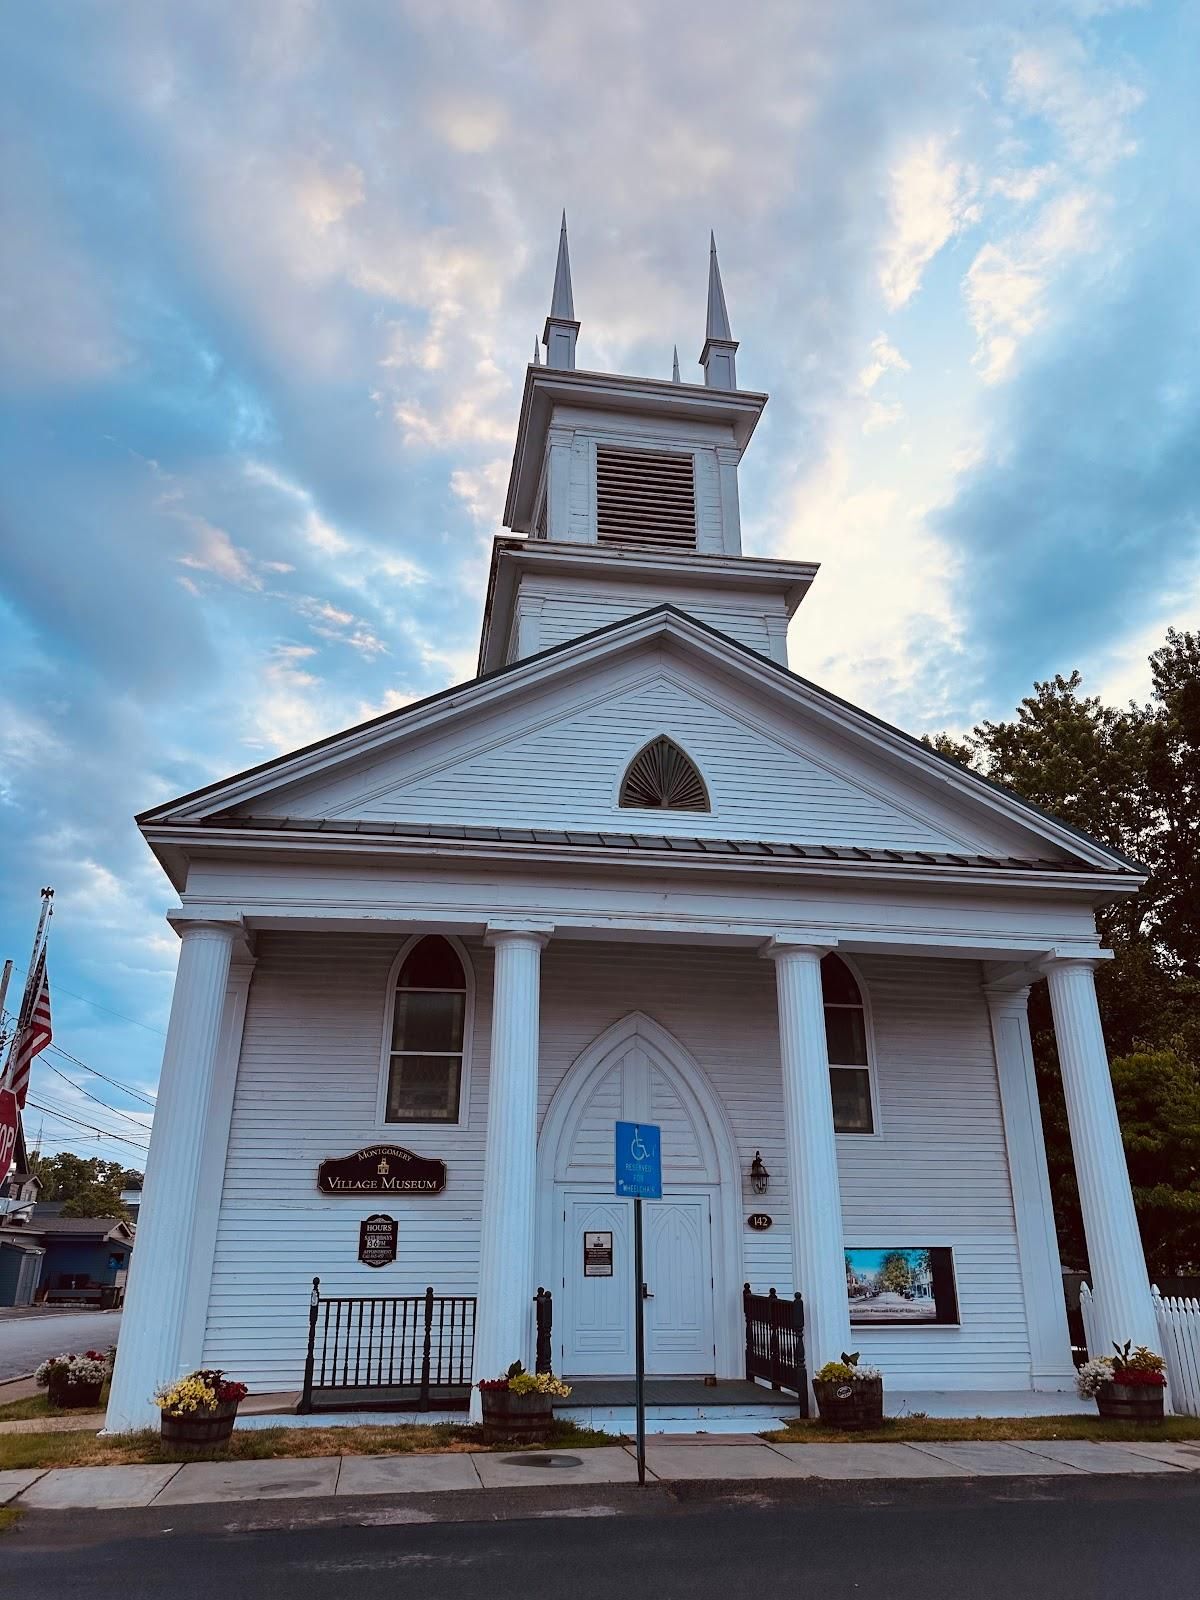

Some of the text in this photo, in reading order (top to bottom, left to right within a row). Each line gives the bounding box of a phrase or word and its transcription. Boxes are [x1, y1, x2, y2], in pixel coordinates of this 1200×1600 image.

[0, 1123, 15, 1163] OP
[358, 1148, 413, 1161] MONTGOMERY
[328, 1177, 436, 1189] VILLAGE MUSEUM
[754, 1216, 768, 1226] 142
[366, 1224, 393, 1232] HOURS
